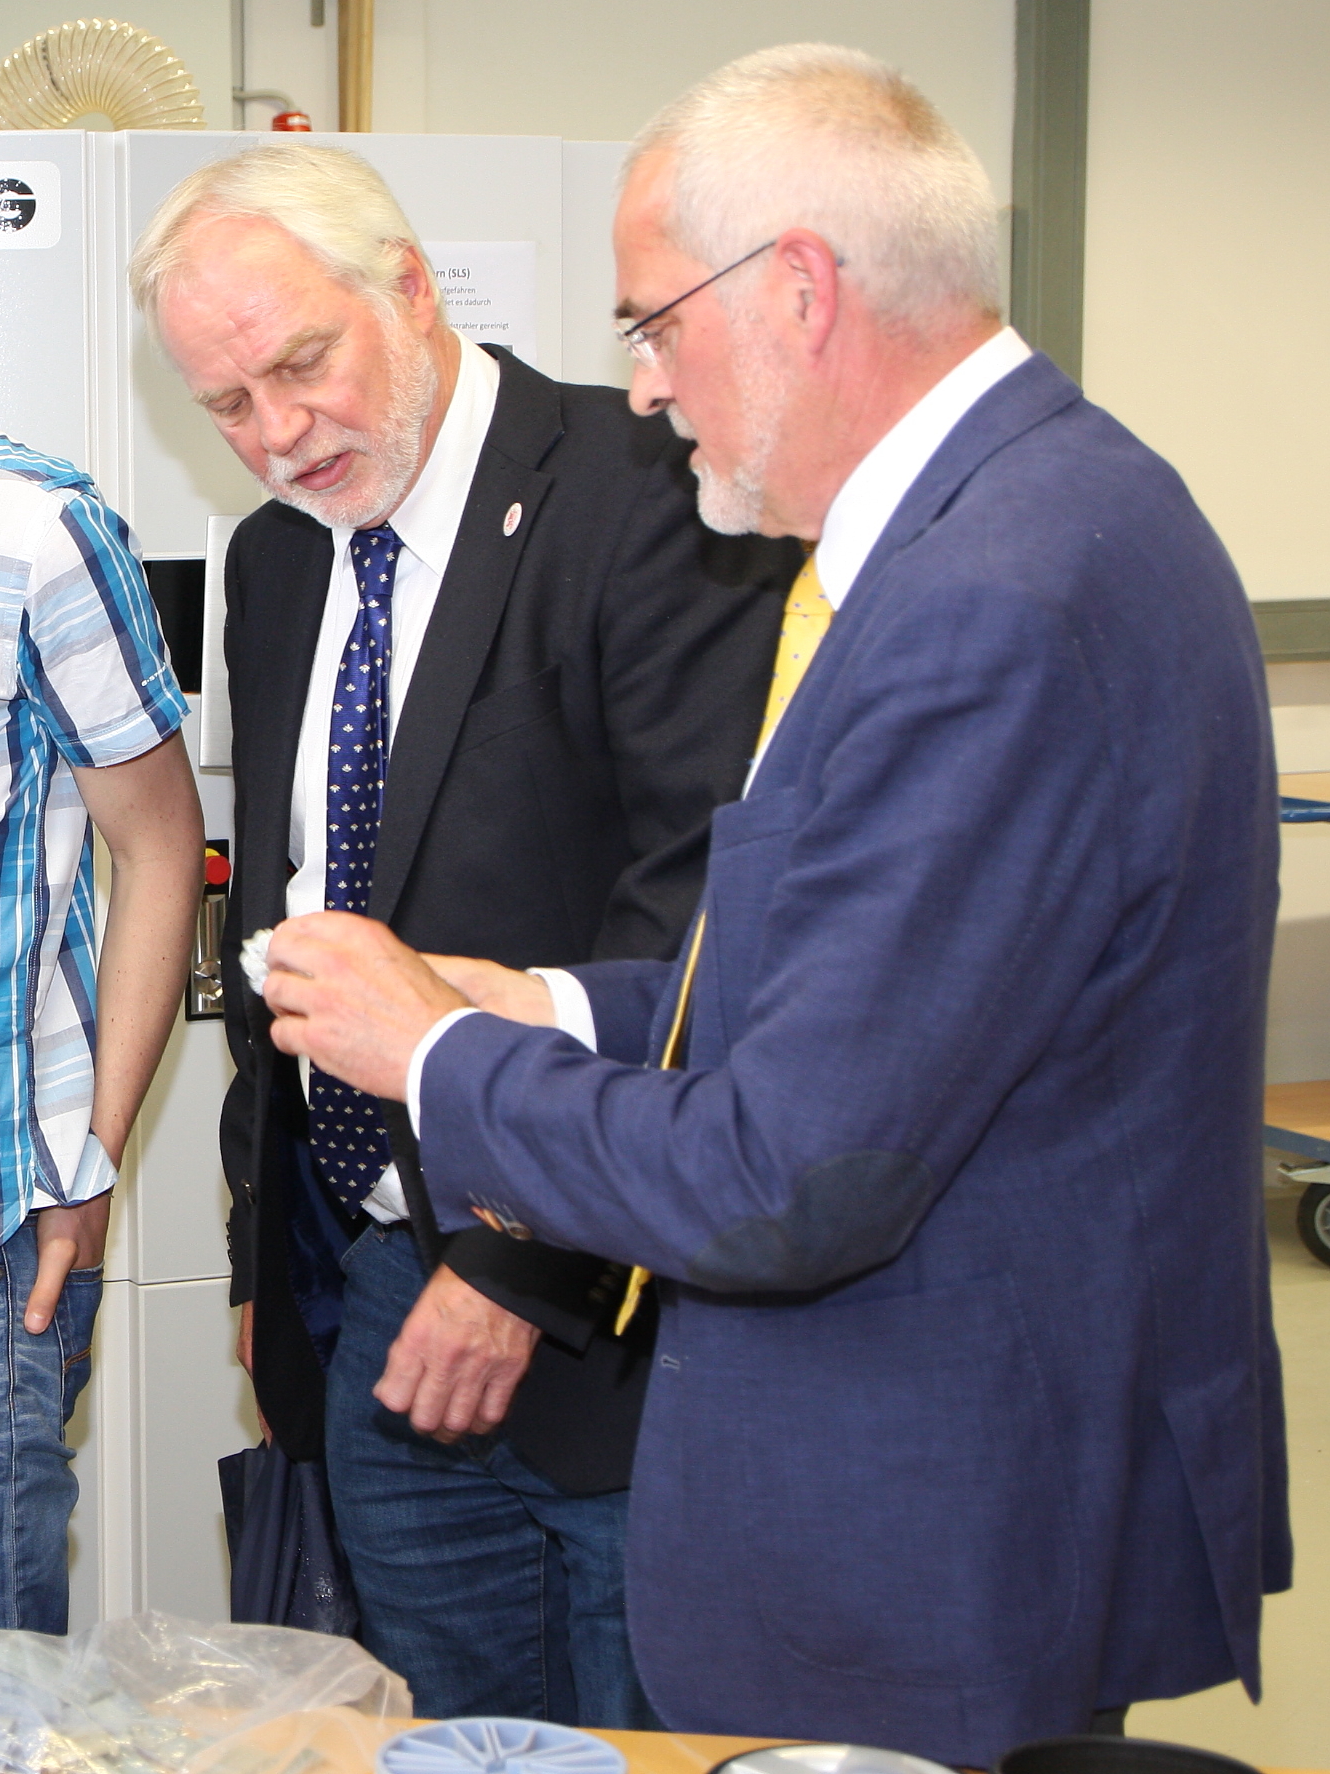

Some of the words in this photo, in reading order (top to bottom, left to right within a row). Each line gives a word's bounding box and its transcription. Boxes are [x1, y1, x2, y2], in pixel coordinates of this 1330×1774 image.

[448, 268, 471, 280] (SLS)
[464, 298, 492, 306] dadurch
[479, 321, 509, 331] gereinigt
